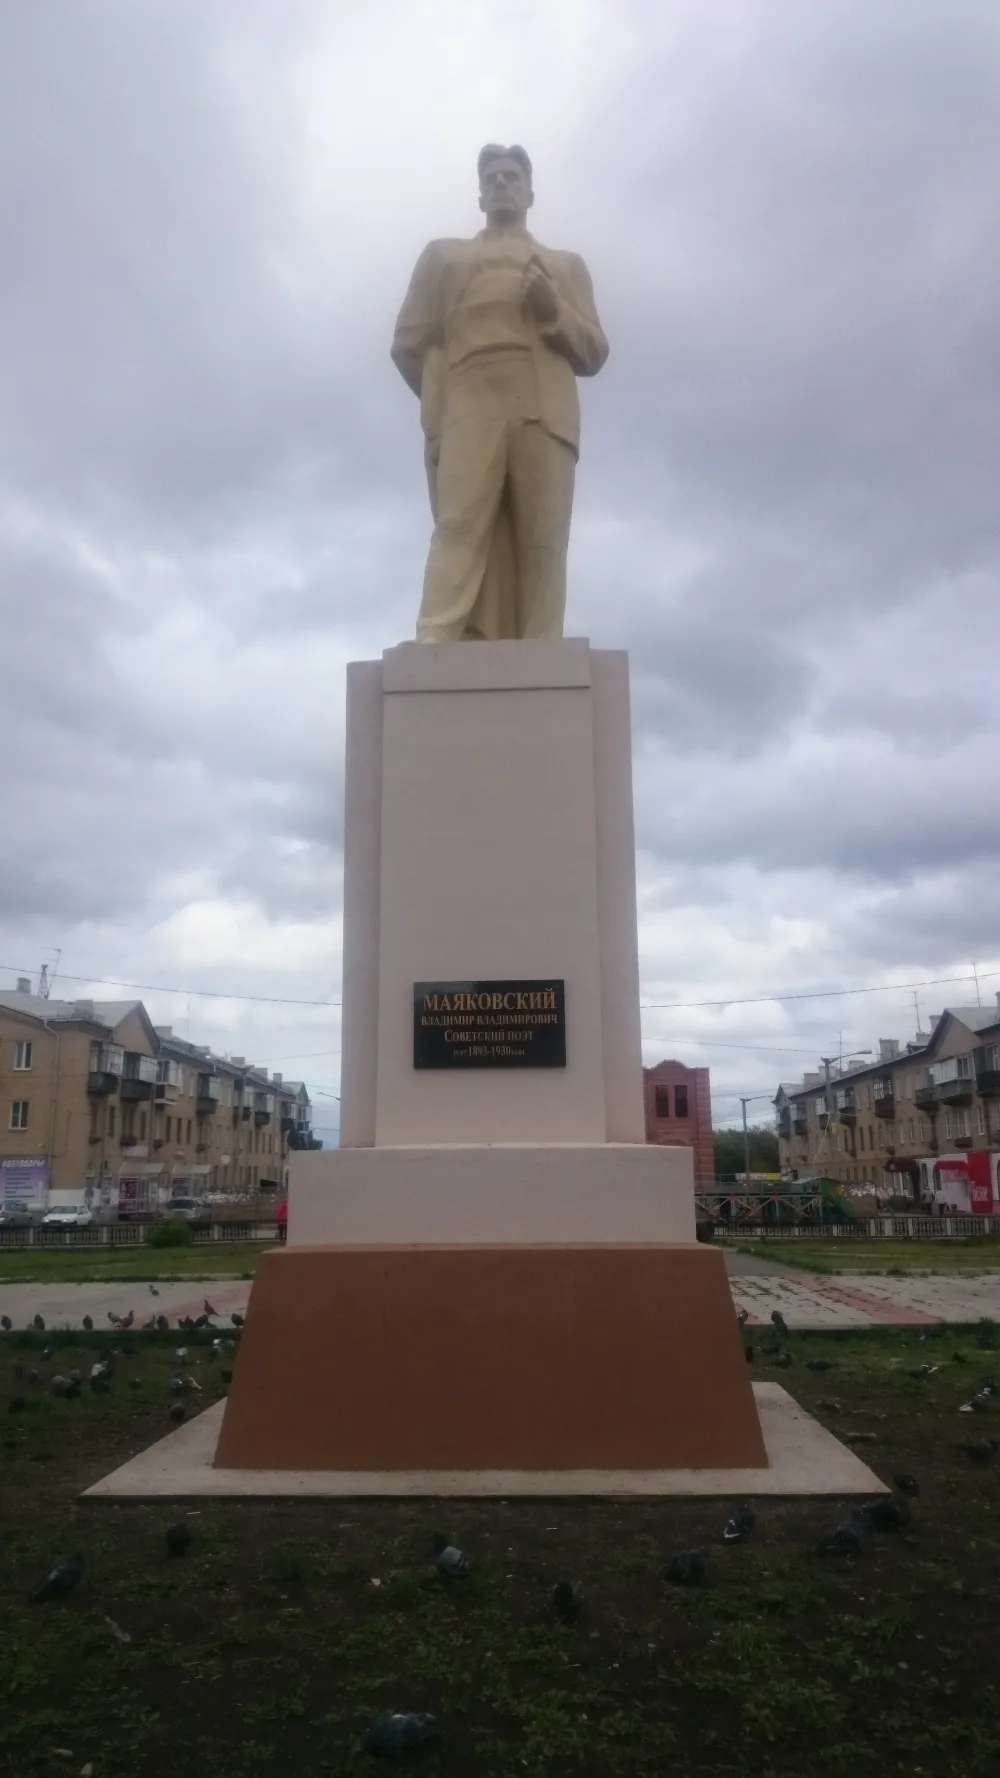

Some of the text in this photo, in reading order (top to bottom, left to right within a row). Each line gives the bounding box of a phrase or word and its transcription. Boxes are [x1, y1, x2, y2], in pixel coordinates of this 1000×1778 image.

[423, 987, 556, 1011] МАЯКОВСКИЙ
[421, 1014, 558, 1026] ВЛАДИМИР ВЛАДИМИРОВИЧ
